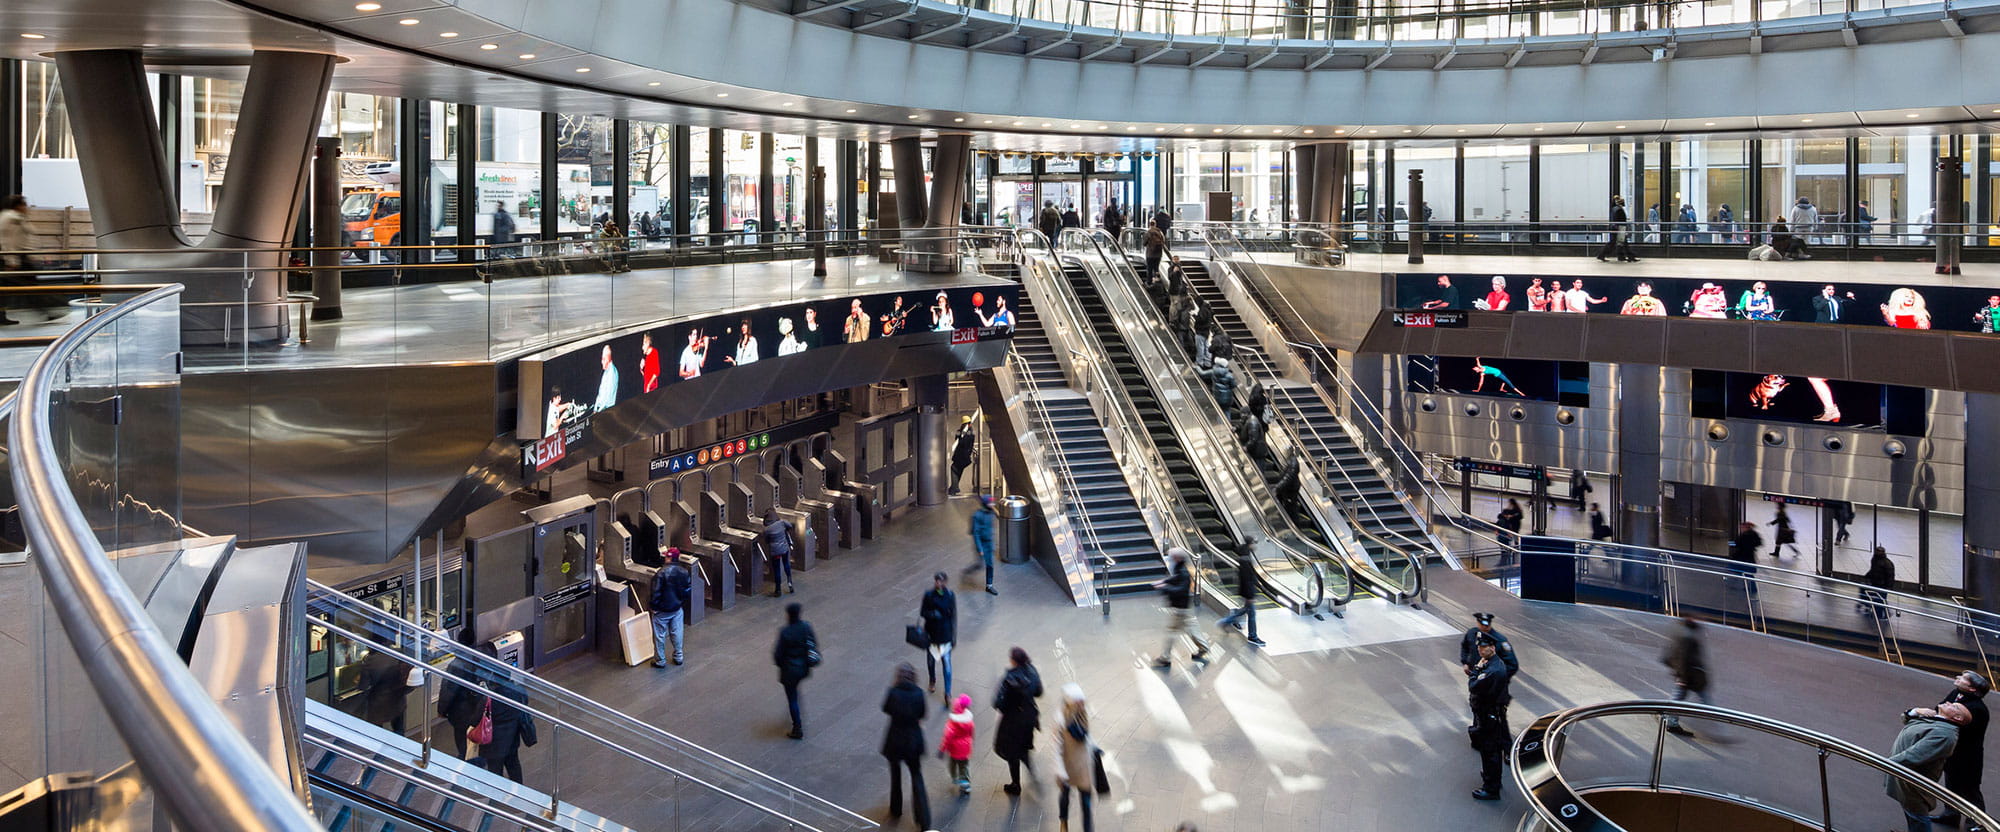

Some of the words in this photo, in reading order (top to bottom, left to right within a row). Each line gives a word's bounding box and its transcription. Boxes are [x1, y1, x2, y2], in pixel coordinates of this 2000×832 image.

[1404, 313, 1432, 325] Exit
[952, 328, 975, 341] Exit
[565, 421, 586, 436] Broadway
[565, 435, 576, 446] John
[576, 431, 582, 440] St
[536, 434, 562, 466] Exit
[650, 459, 670, 470] Entry
[672, 460, 680, 470] A
[686, 455, 694, 466] C
[713, 449, 720, 459] Z
[726, 445, 733, 455] 2
[738, 442, 744, 451] 3
[750, 438, 756, 447] 4
[761, 435, 768, 445] 5
[367, 584, 378, 594] St
